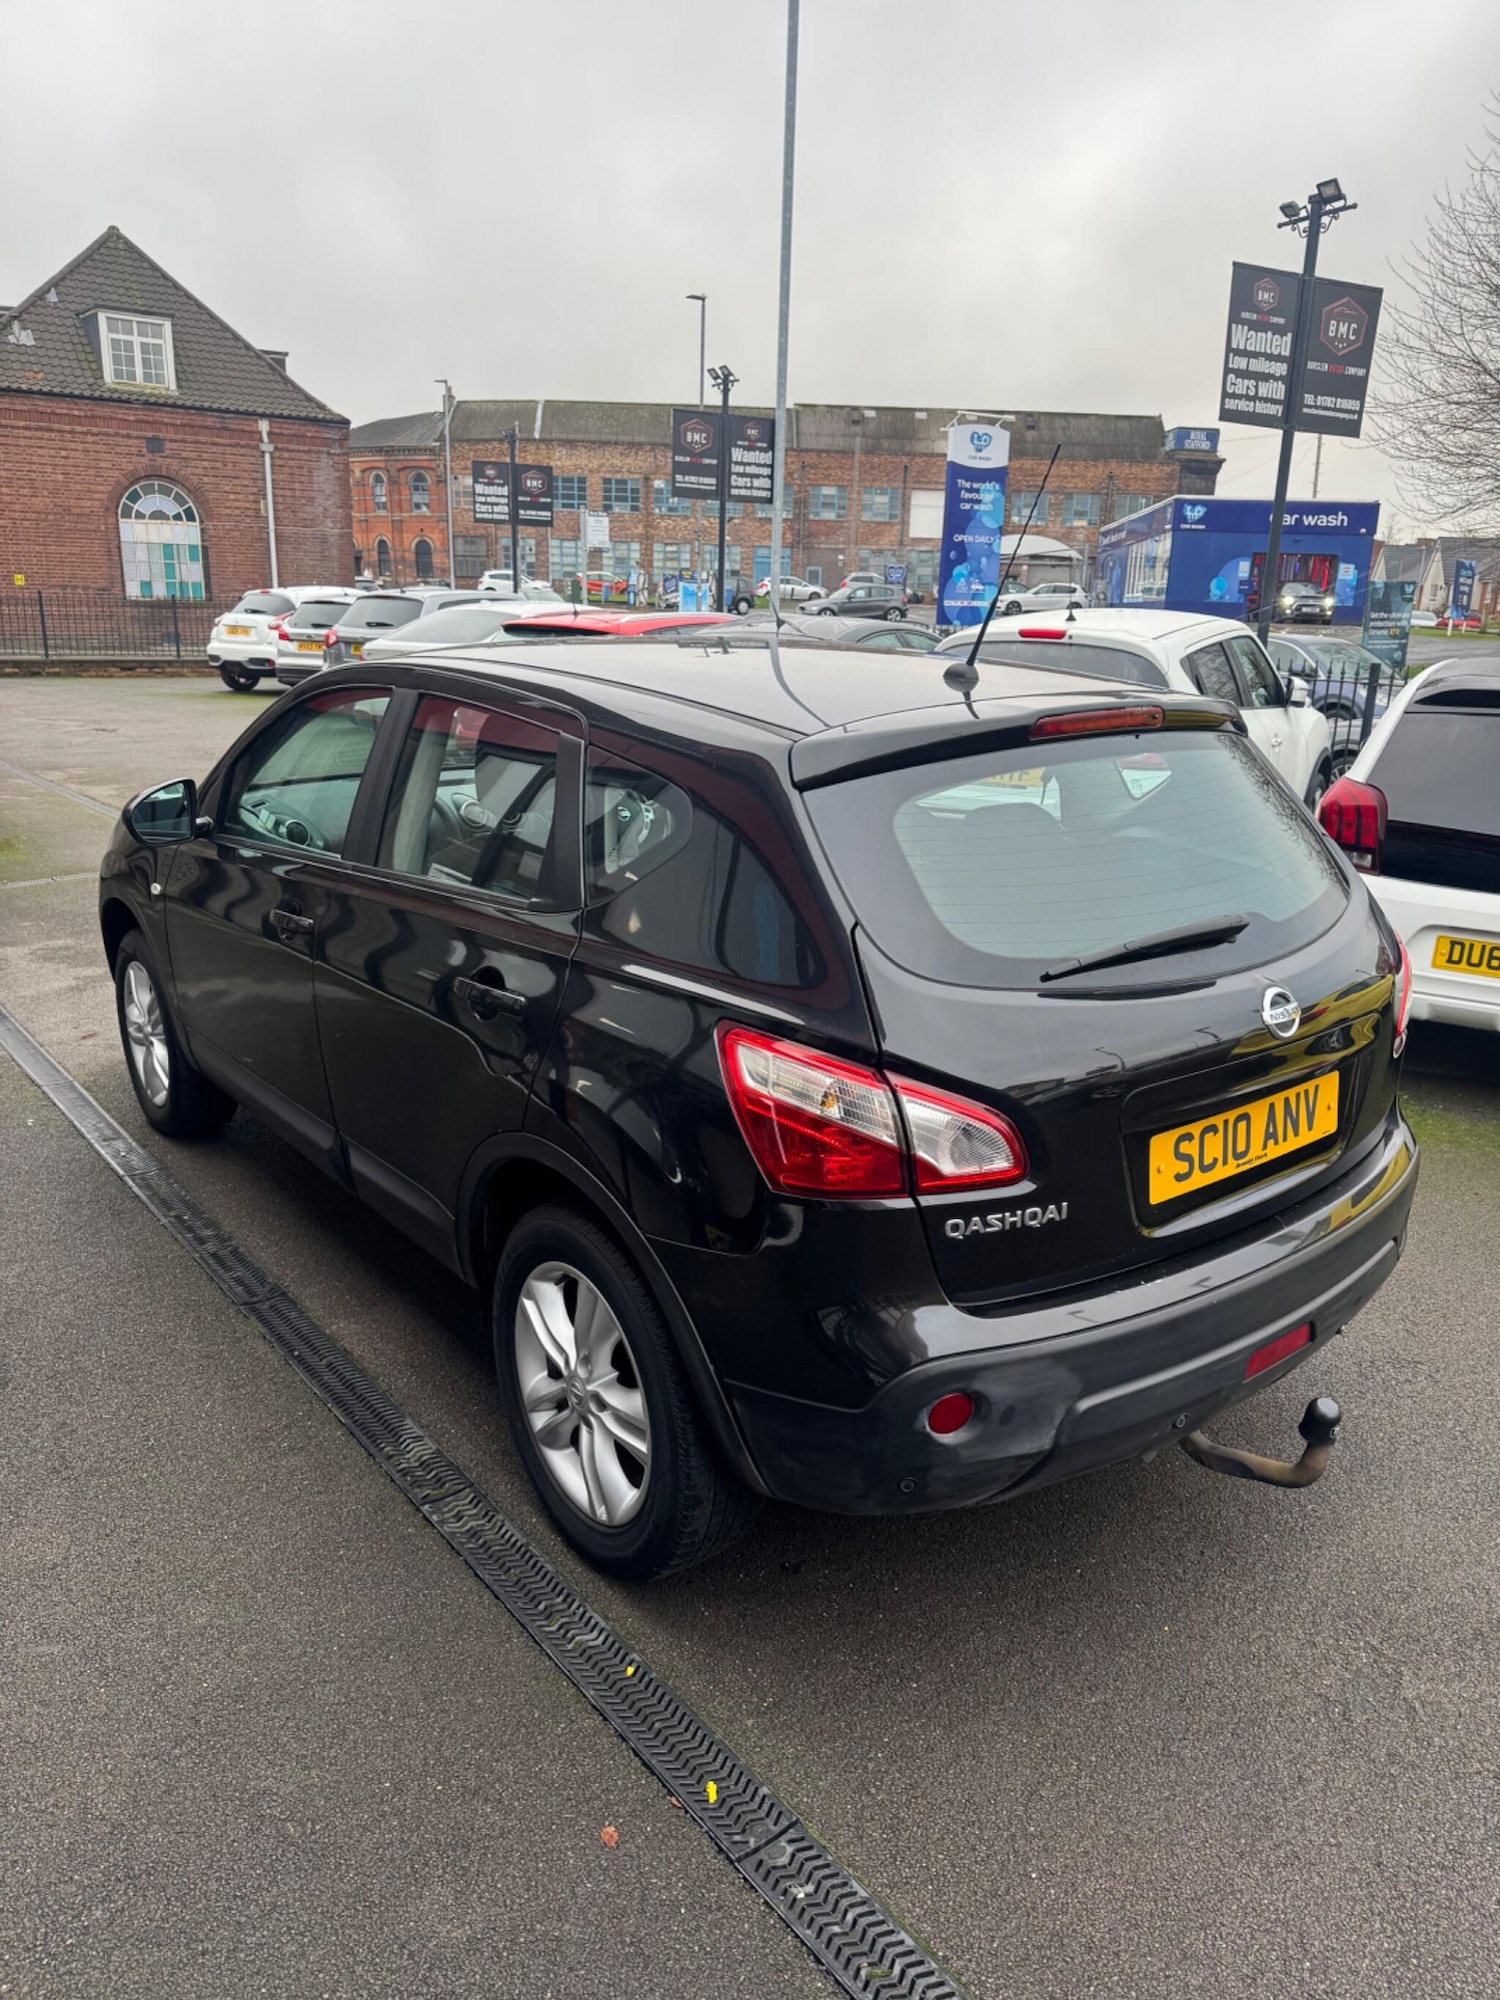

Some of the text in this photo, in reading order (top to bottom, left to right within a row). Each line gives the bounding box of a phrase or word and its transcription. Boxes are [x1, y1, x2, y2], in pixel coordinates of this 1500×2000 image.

[1258, 290, 1274, 302] BMC
[1328, 320, 1358, 340] BMC
[1231, 323, 1293, 357] Wanted
[1228, 352, 1288, 377] Low mileage
[1226, 373, 1286, 400] Cars with
[1224, 398, 1284, 417] service history
[686, 431, 708, 444] BMC
[731, 447, 773, 465] Wanted
[731, 463, 772, 476] Low mileage
[526, 479, 543, 488] BMC
[731, 474, 751, 487] Cars
[752, 476, 772, 489] with
[957, 479, 971, 488] The
[474, 483, 508, 496] Wanted
[960, 502, 993, 511] car wash
[1302, 511, 1348, 527] wash
[953, 534, 995, 543] OPEN DAILY
[1173, 1084, 1320, 1183] SC10 ANV
[944, 1201, 1069, 1240] QASHQAI
